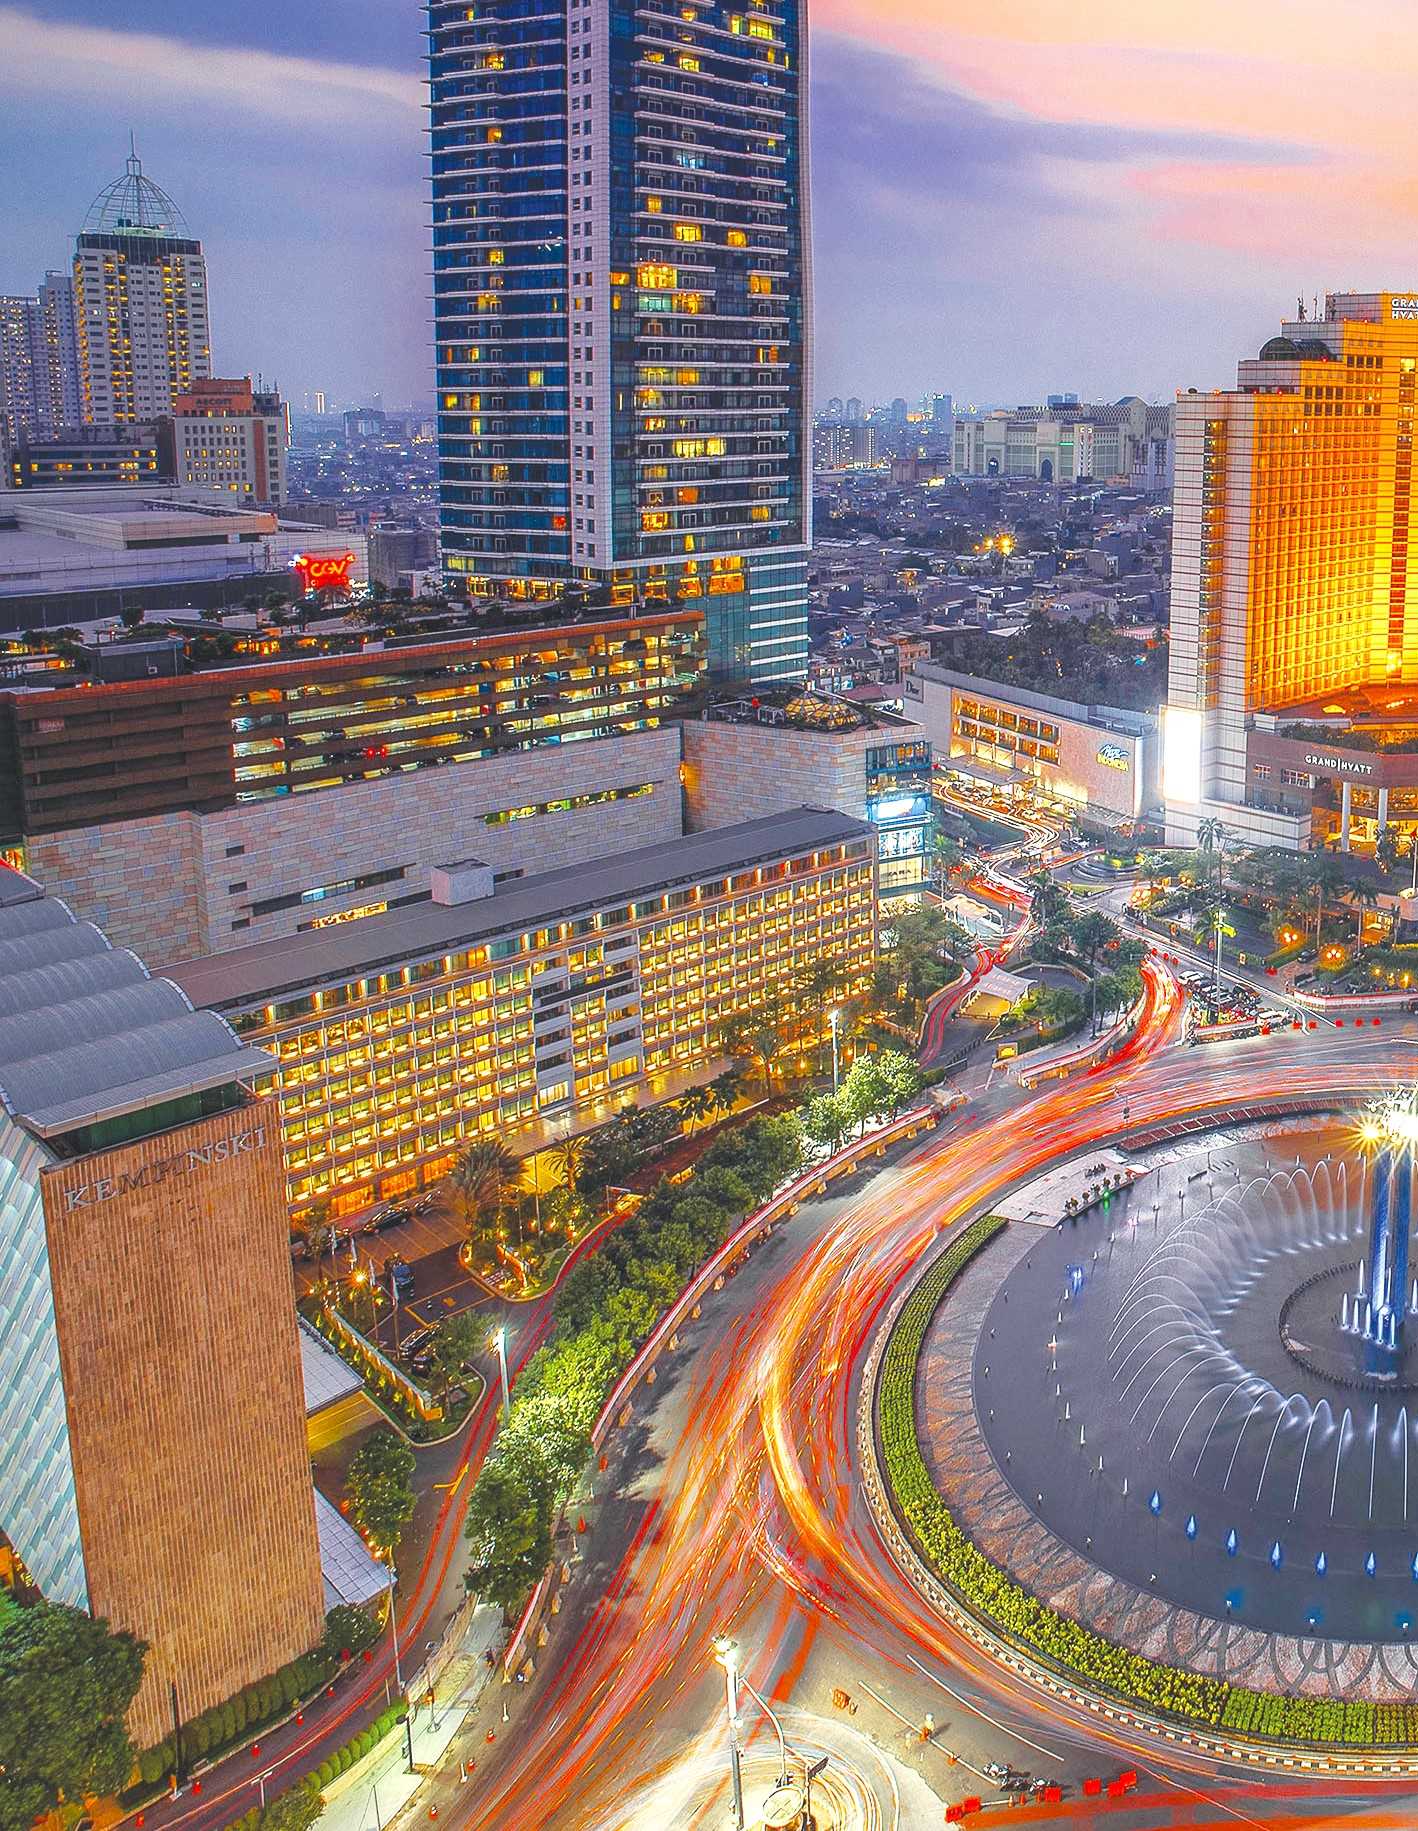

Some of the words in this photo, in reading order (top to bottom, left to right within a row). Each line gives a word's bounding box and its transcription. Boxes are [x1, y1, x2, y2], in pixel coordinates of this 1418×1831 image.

[310, 561, 346, 577] CGV
[1304, 754, 1338, 768] GRAND
[1341, 761, 1373, 775] HYATT
[63, 1126, 267, 1214] KEMPINSKI
